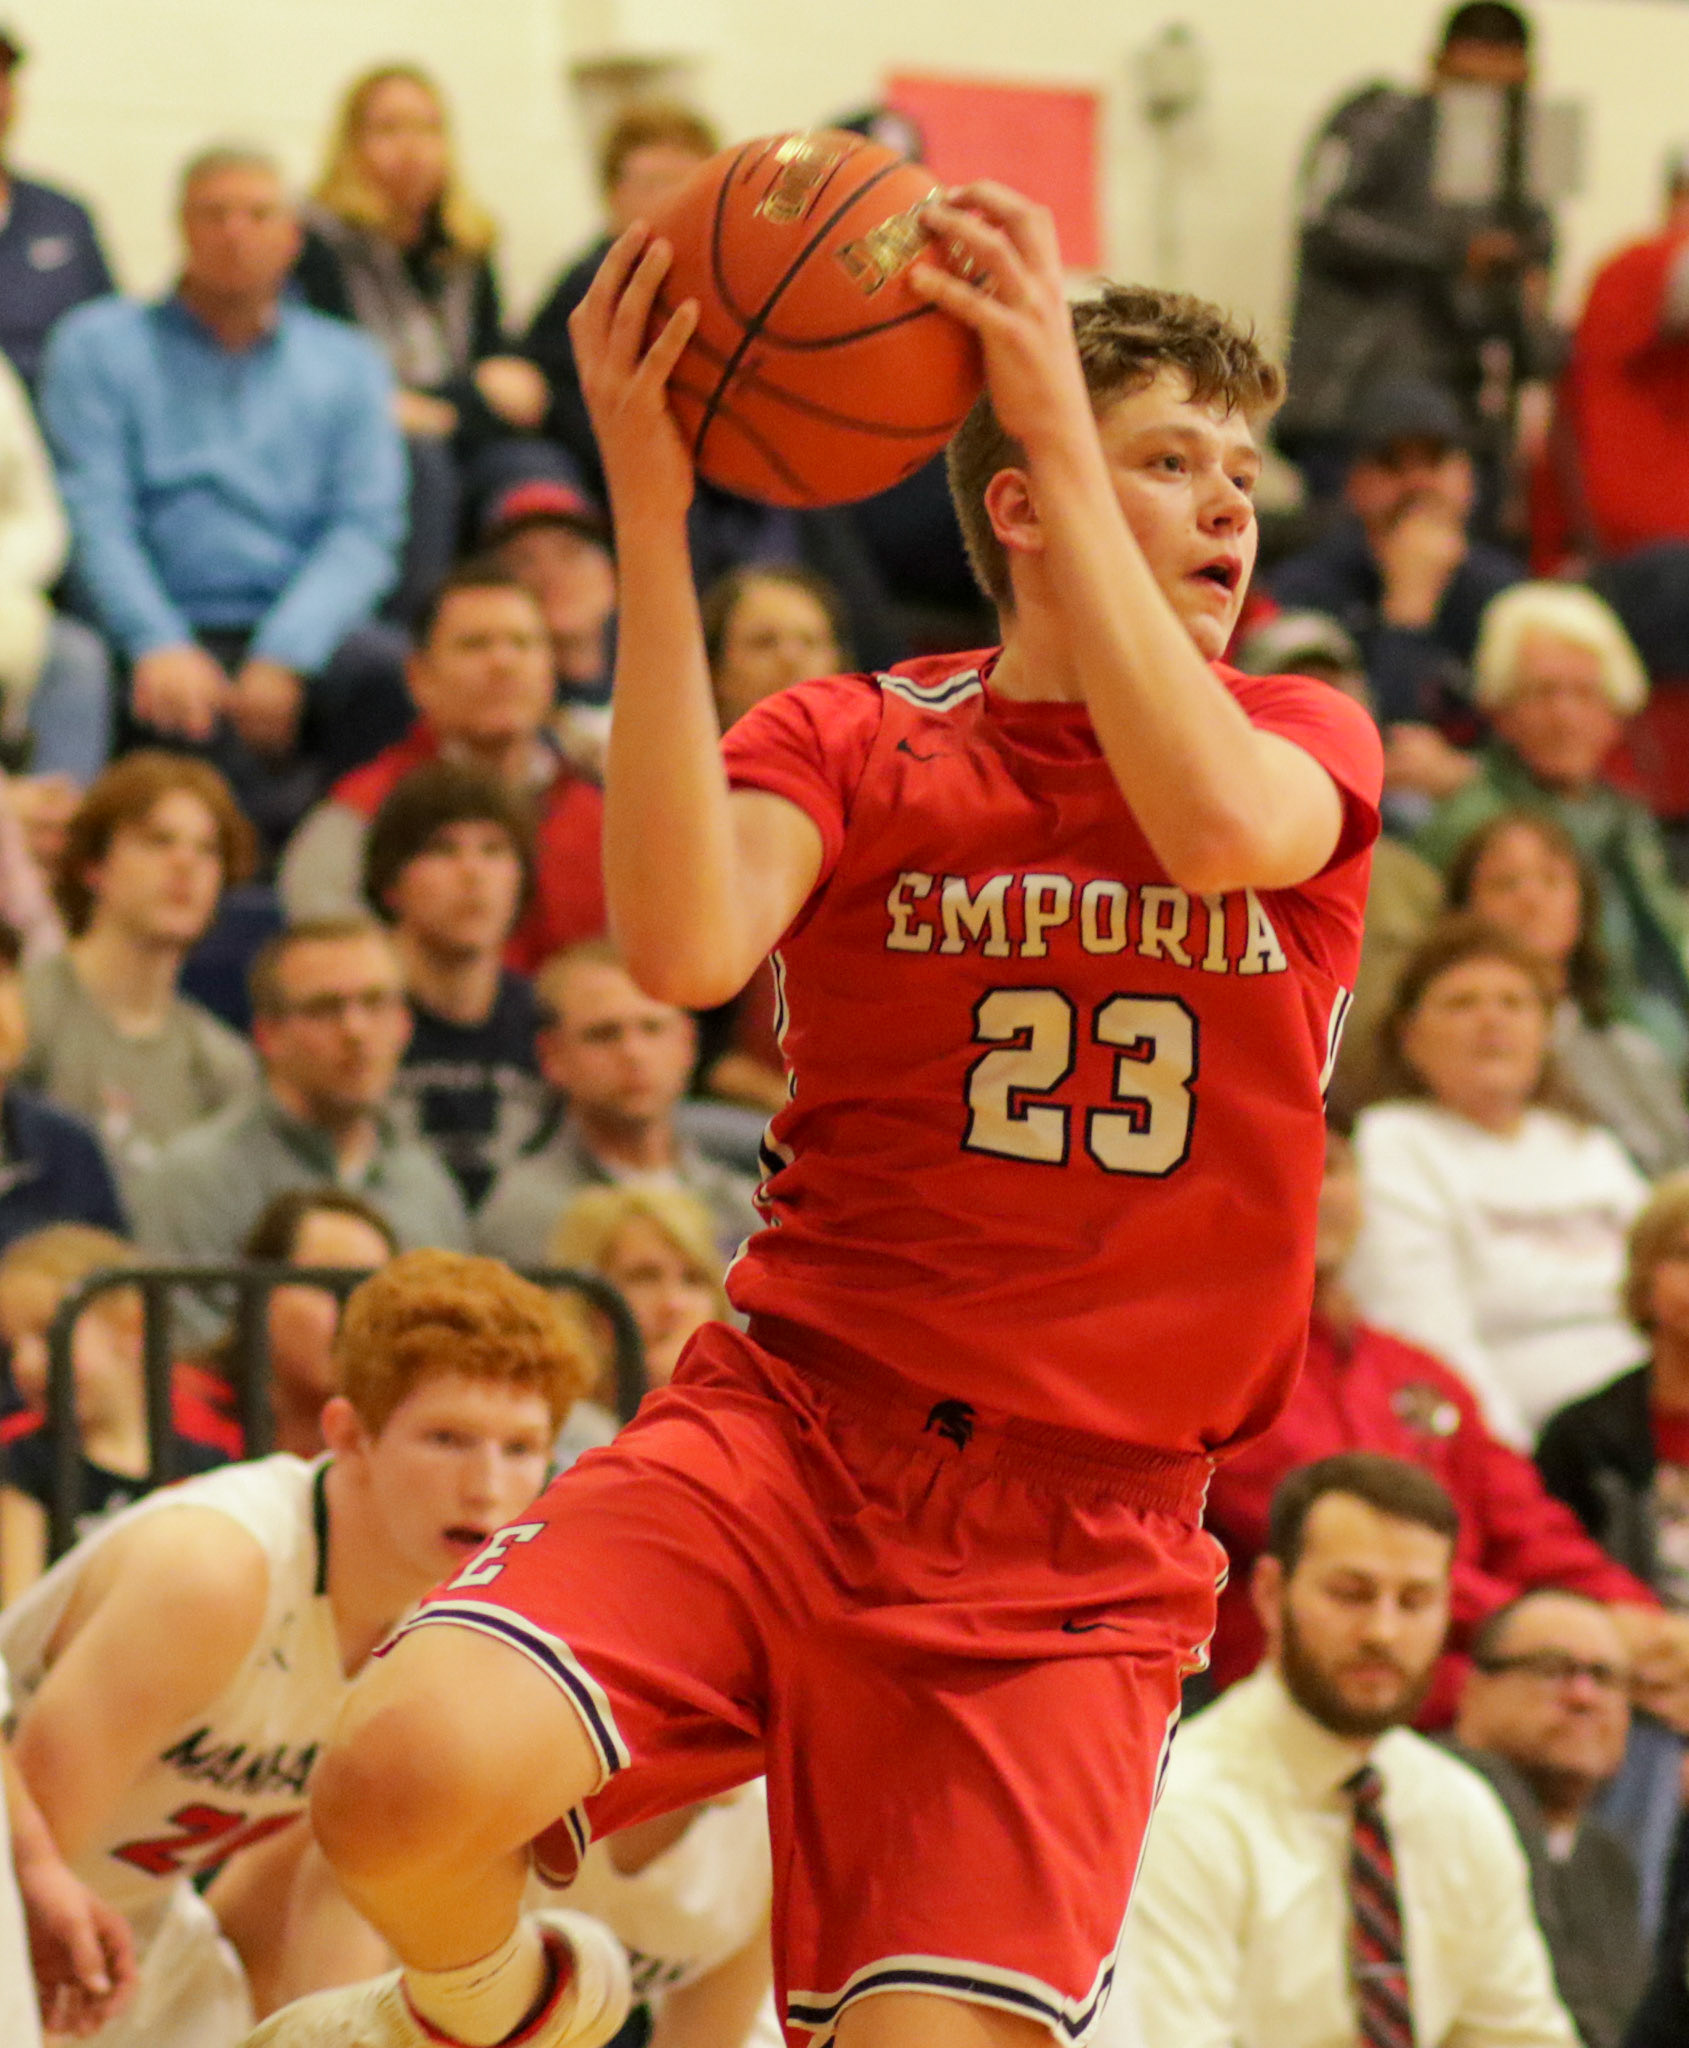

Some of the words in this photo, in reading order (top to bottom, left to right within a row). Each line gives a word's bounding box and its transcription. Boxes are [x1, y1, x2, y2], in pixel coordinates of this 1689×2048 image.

[885, 870, 1288, 976] EMPORIA
[960, 985, 1199, 1179] 23
[445, 1521, 548, 1592] E
